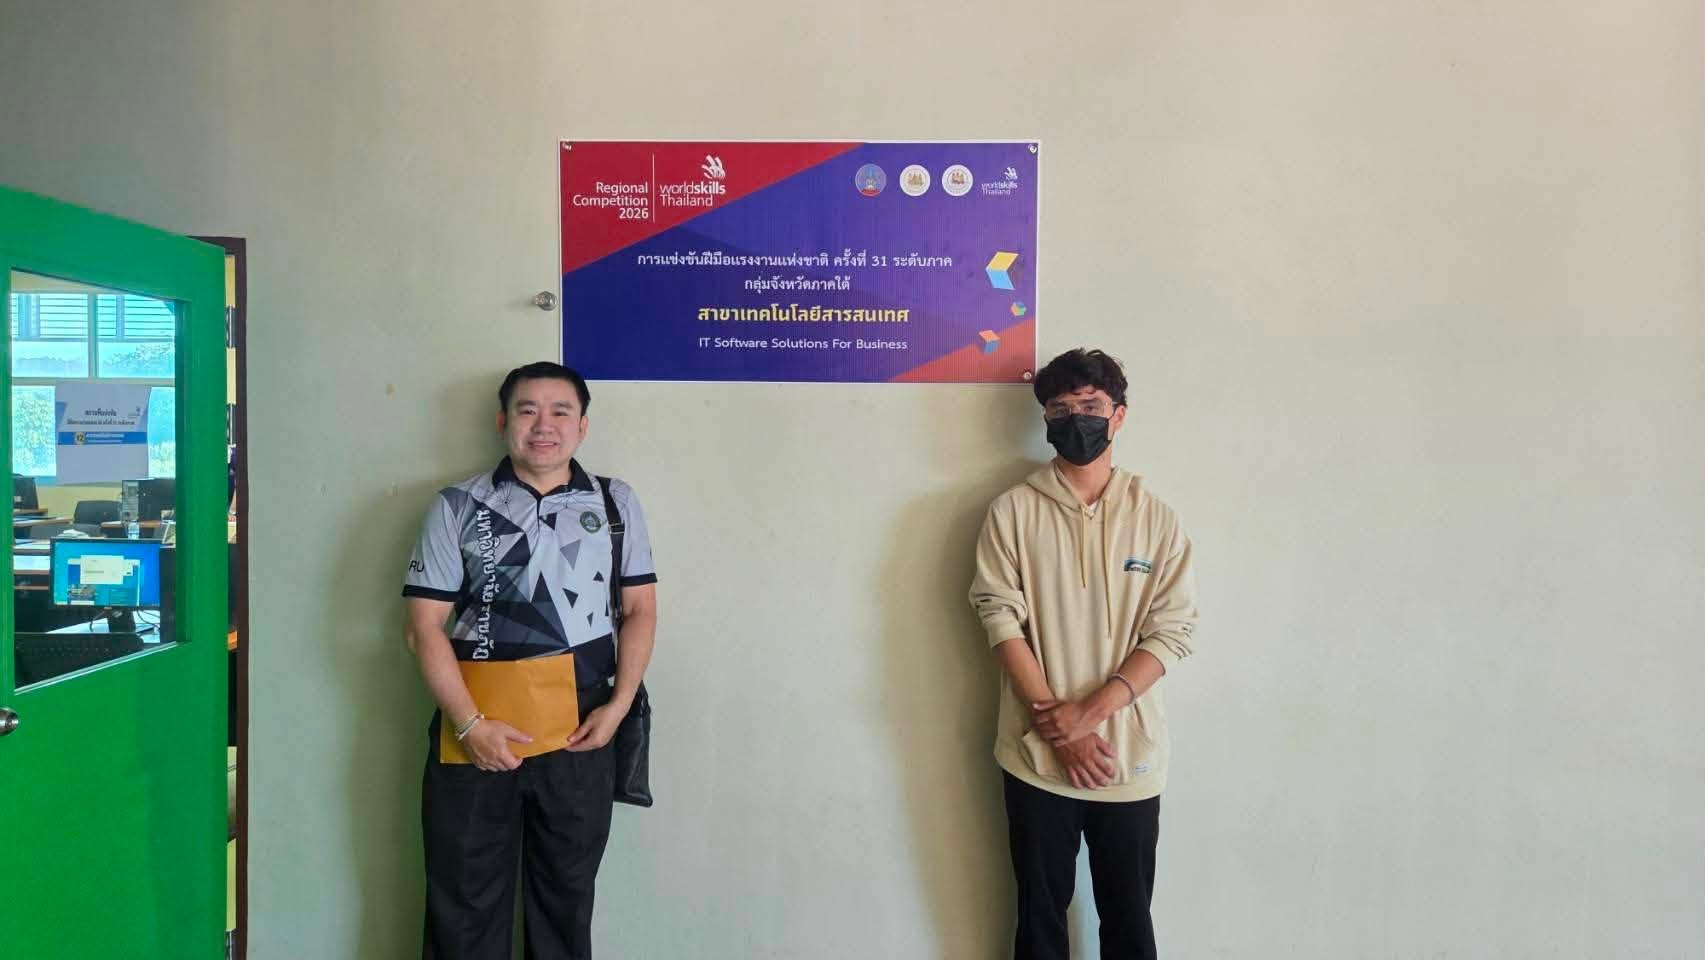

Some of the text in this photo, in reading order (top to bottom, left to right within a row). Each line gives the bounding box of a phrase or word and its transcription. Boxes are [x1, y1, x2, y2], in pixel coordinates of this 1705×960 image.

[596, 181, 648, 195] Regional
[659, 181, 726, 194] worldskills
[573, 194, 648, 208] Competition
[660, 194, 713, 207] Thailand
[618, 207, 649, 220] 2026
[637, 248, 953, 267] การแข่งขันฝีมือแรงงานแห่งชาติ ครั้งที่ 31 ระดับภาค
[744, 273, 850, 293] กลุ่มจังหวัดภาคใต้
[697, 304, 910, 322] สาขาเทคโนโลยีสารสนเทศ
[699, 337, 908, 350] IT Software Solutions For Business
